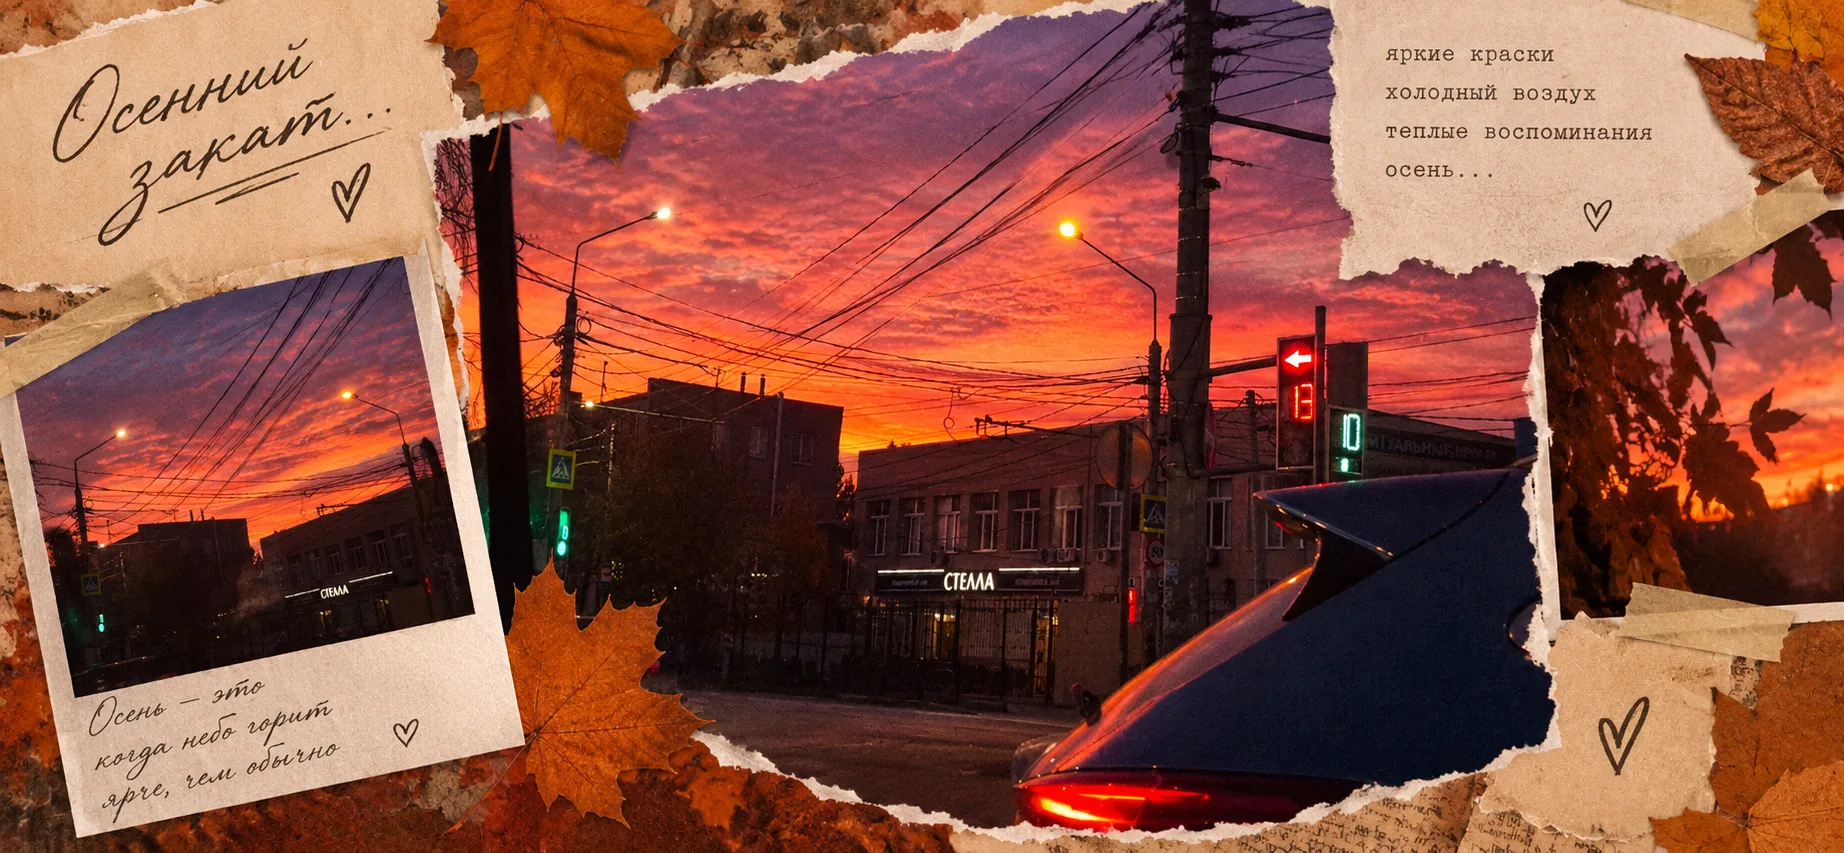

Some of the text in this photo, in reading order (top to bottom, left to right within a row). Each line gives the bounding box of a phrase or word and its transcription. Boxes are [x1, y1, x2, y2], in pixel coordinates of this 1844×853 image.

[1385, 48, 1555, 67] яркие краски
[53, 38, 314, 163] Осенний
[1385, 85, 1597, 105] холодный воздух
[1385, 125, 1653, 142] теплые воспоминания
[98, 93, 391, 246] закат...
[1385, 163, 1495, 179] осень...
[943, 571, 995, 592] СТЕЛЛА
[88, 695, 167, 736] Осень
[211, 678, 266, 704] это
[94, 699, 334, 781] когда небо горит
[101, 742, 341, 824] ярче, чем обычно
